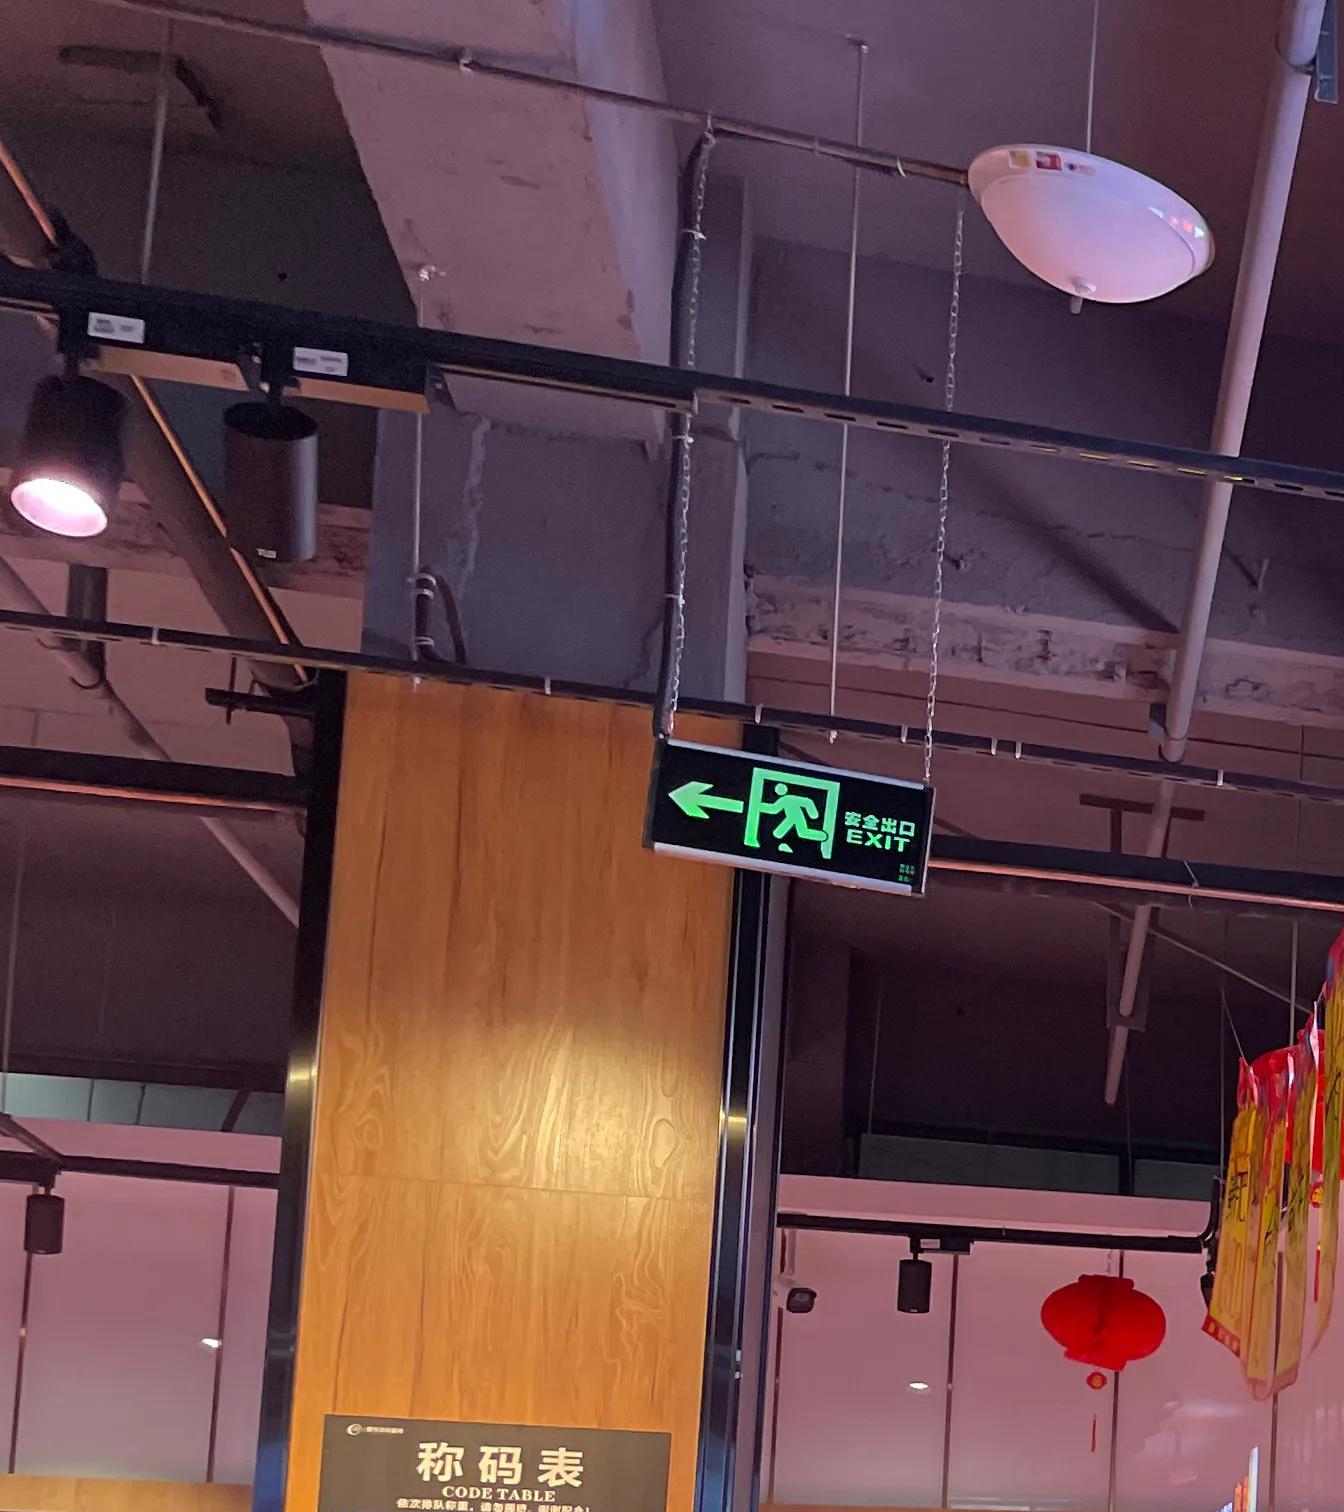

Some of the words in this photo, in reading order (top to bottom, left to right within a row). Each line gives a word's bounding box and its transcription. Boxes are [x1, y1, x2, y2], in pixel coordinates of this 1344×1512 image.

[844, 811, 916, 838] 安全出口
[846, 828, 911, 853] EXIT
[416, 1441, 585, 1488] 称码表
[441, 1485, 493, 1500] CODE
[497, 1488, 556, 1503] TABLE
